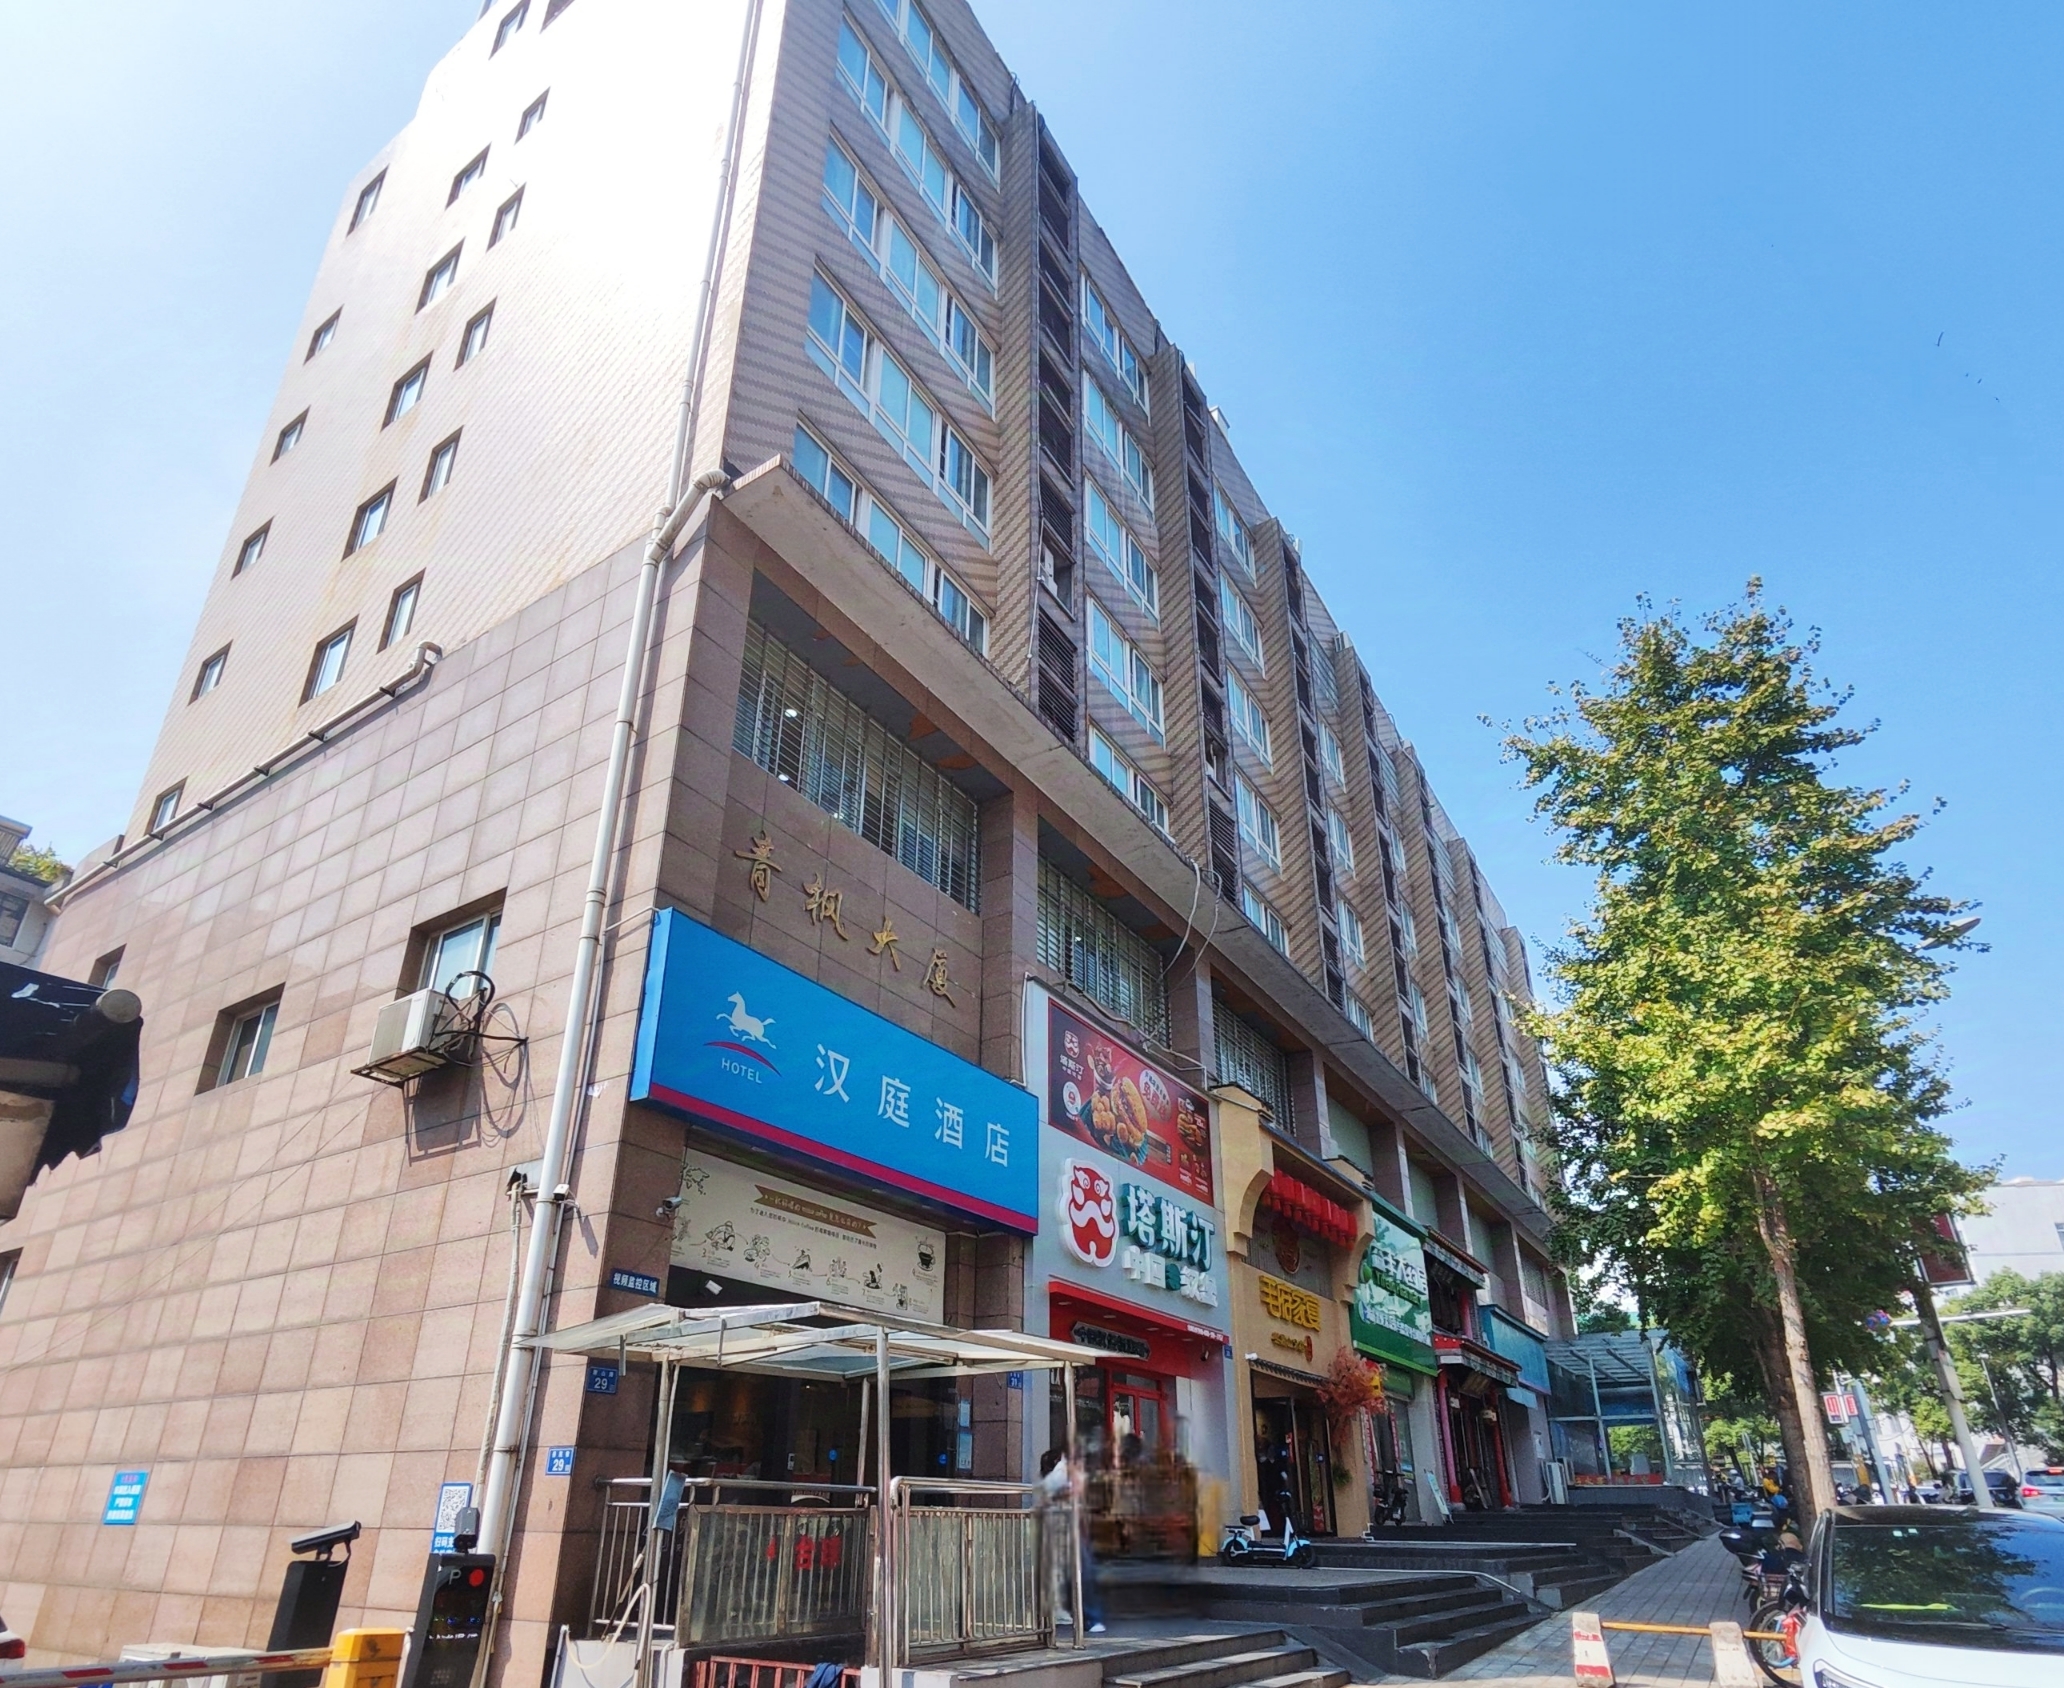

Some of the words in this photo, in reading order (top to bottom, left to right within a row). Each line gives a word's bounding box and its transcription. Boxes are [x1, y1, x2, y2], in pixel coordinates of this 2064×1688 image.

[721, 1057, 763, 1084] HOTEL
[814, 1043, 1010, 1168] 汉庭酒店
[1126, 1184, 1215, 1272] 塔斯汀
[613, 1272, 657, 1294] 视频监控区域
[594, 1377, 608, 1390] 29
[552, 1458, 565, 1472] 29
